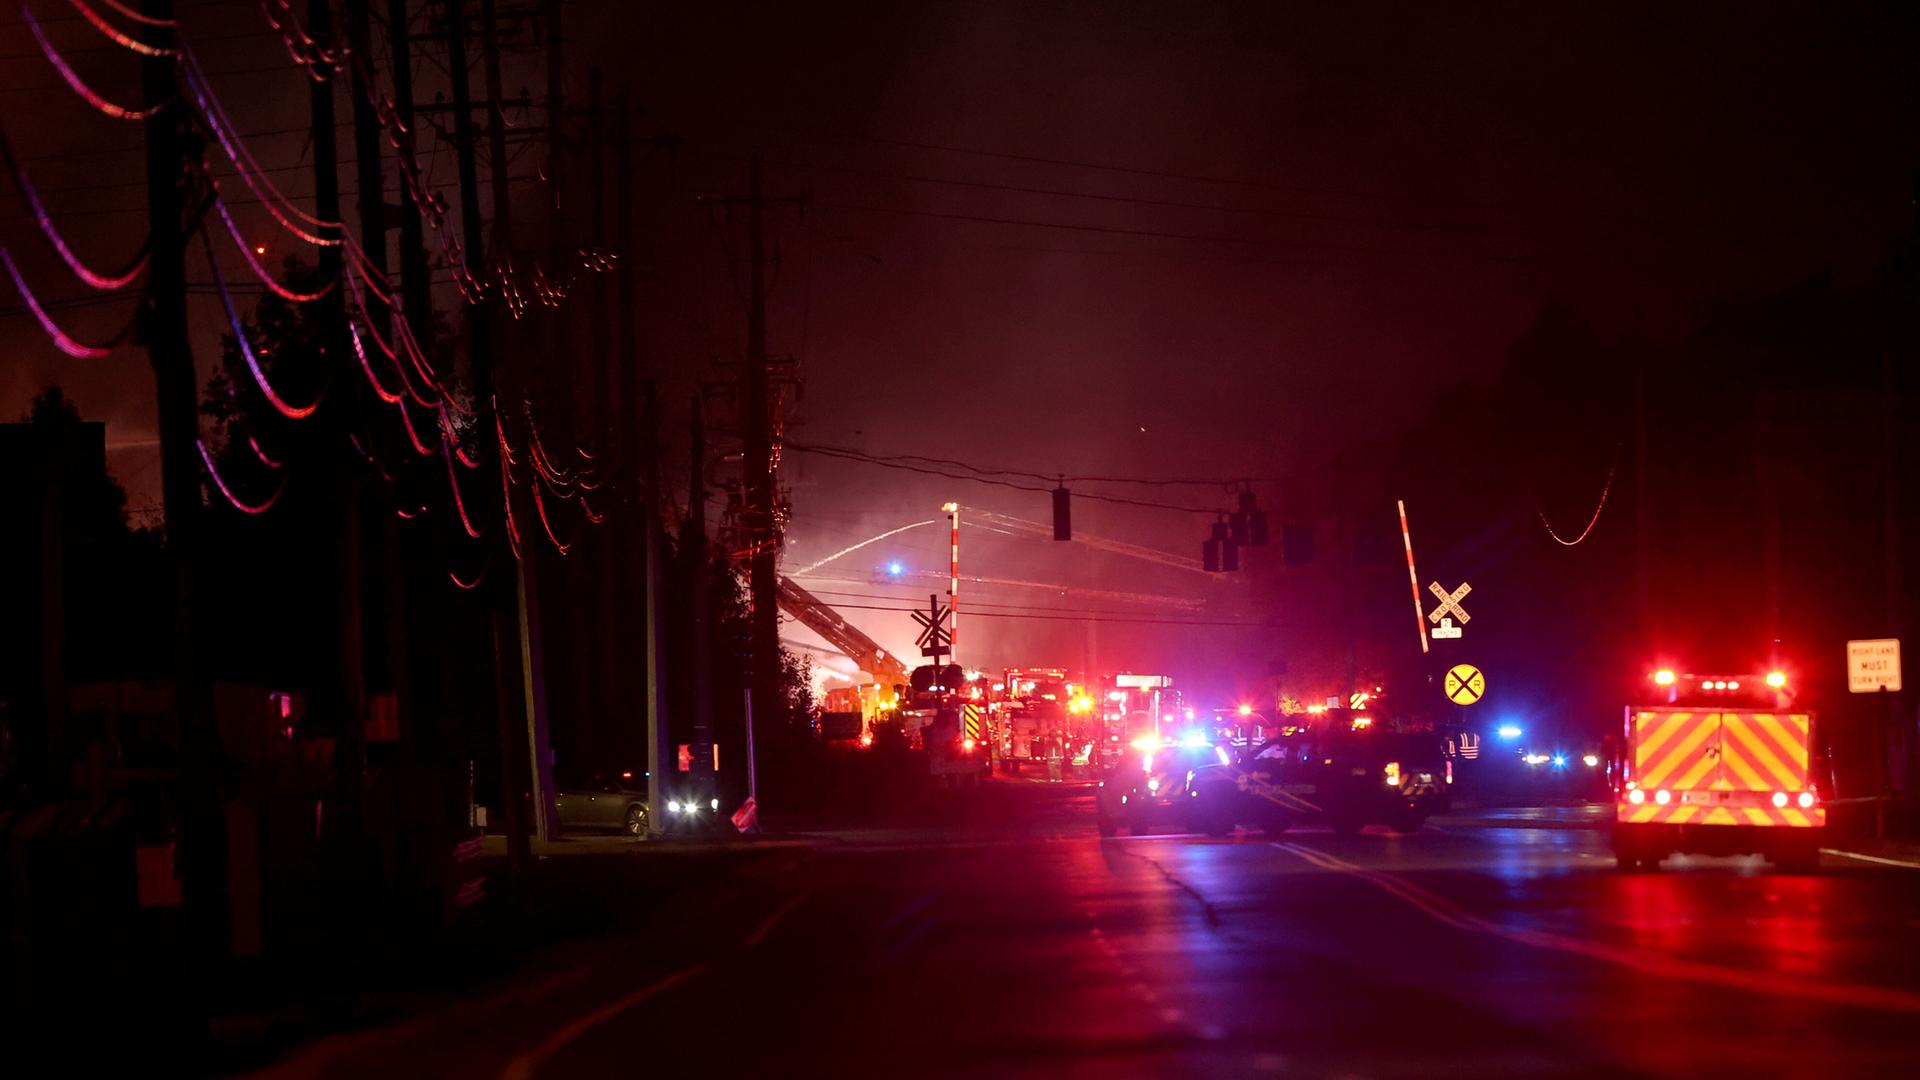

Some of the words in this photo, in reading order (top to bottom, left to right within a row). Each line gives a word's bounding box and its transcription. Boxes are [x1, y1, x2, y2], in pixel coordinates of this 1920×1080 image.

[1431, 584, 1470, 622] CROSSING
[1852, 647, 1873, 655] RIGHT
[1876, 647, 1895, 655] LANE
[1861, 660, 1888, 670] MUST
[1448, 680, 1455, 689] R
[1474, 680, 1481, 689] R
[1853, 676, 1873, 685] TURN
[1876, 675, 1897, 684] RIGHT
